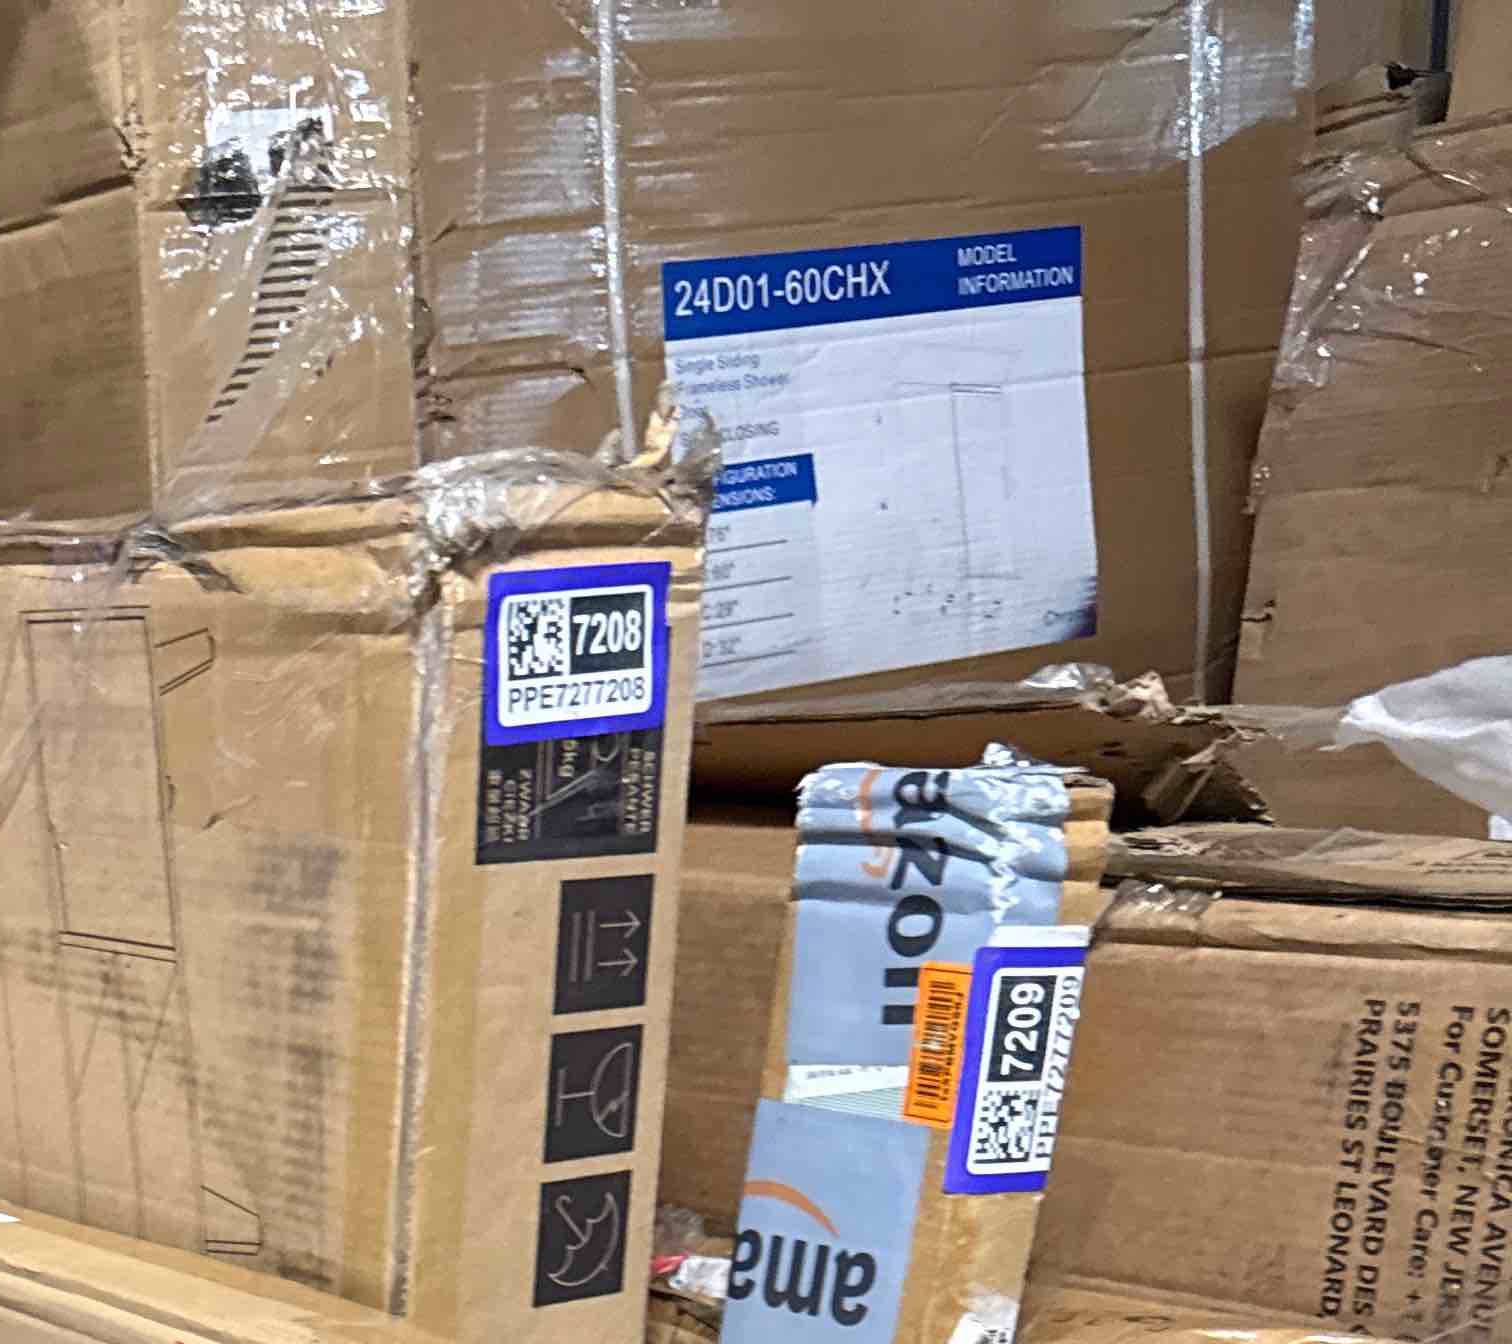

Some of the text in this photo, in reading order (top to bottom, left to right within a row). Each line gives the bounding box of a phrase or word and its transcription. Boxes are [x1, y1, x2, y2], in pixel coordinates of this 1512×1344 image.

[674, 243, 1017, 317] 24D01-60CHX MODEL
[957, 266, 1074, 296] INFORMATION
[572, 610, 642, 656] 7208
[508, 676, 645, 712] PPE7277208
[1000, 980, 1046, 1077] 7209
[1441, 1005, 1476, 1056] For
[1034, 974, 1082, 1159] PPE7277209
[1312, 999, 1387, 1320] PRAIRIES ST LEONARD,
[1445, 1184, 1480, 1258] NEW
[1350, 1264, 1381, 1319] DES
